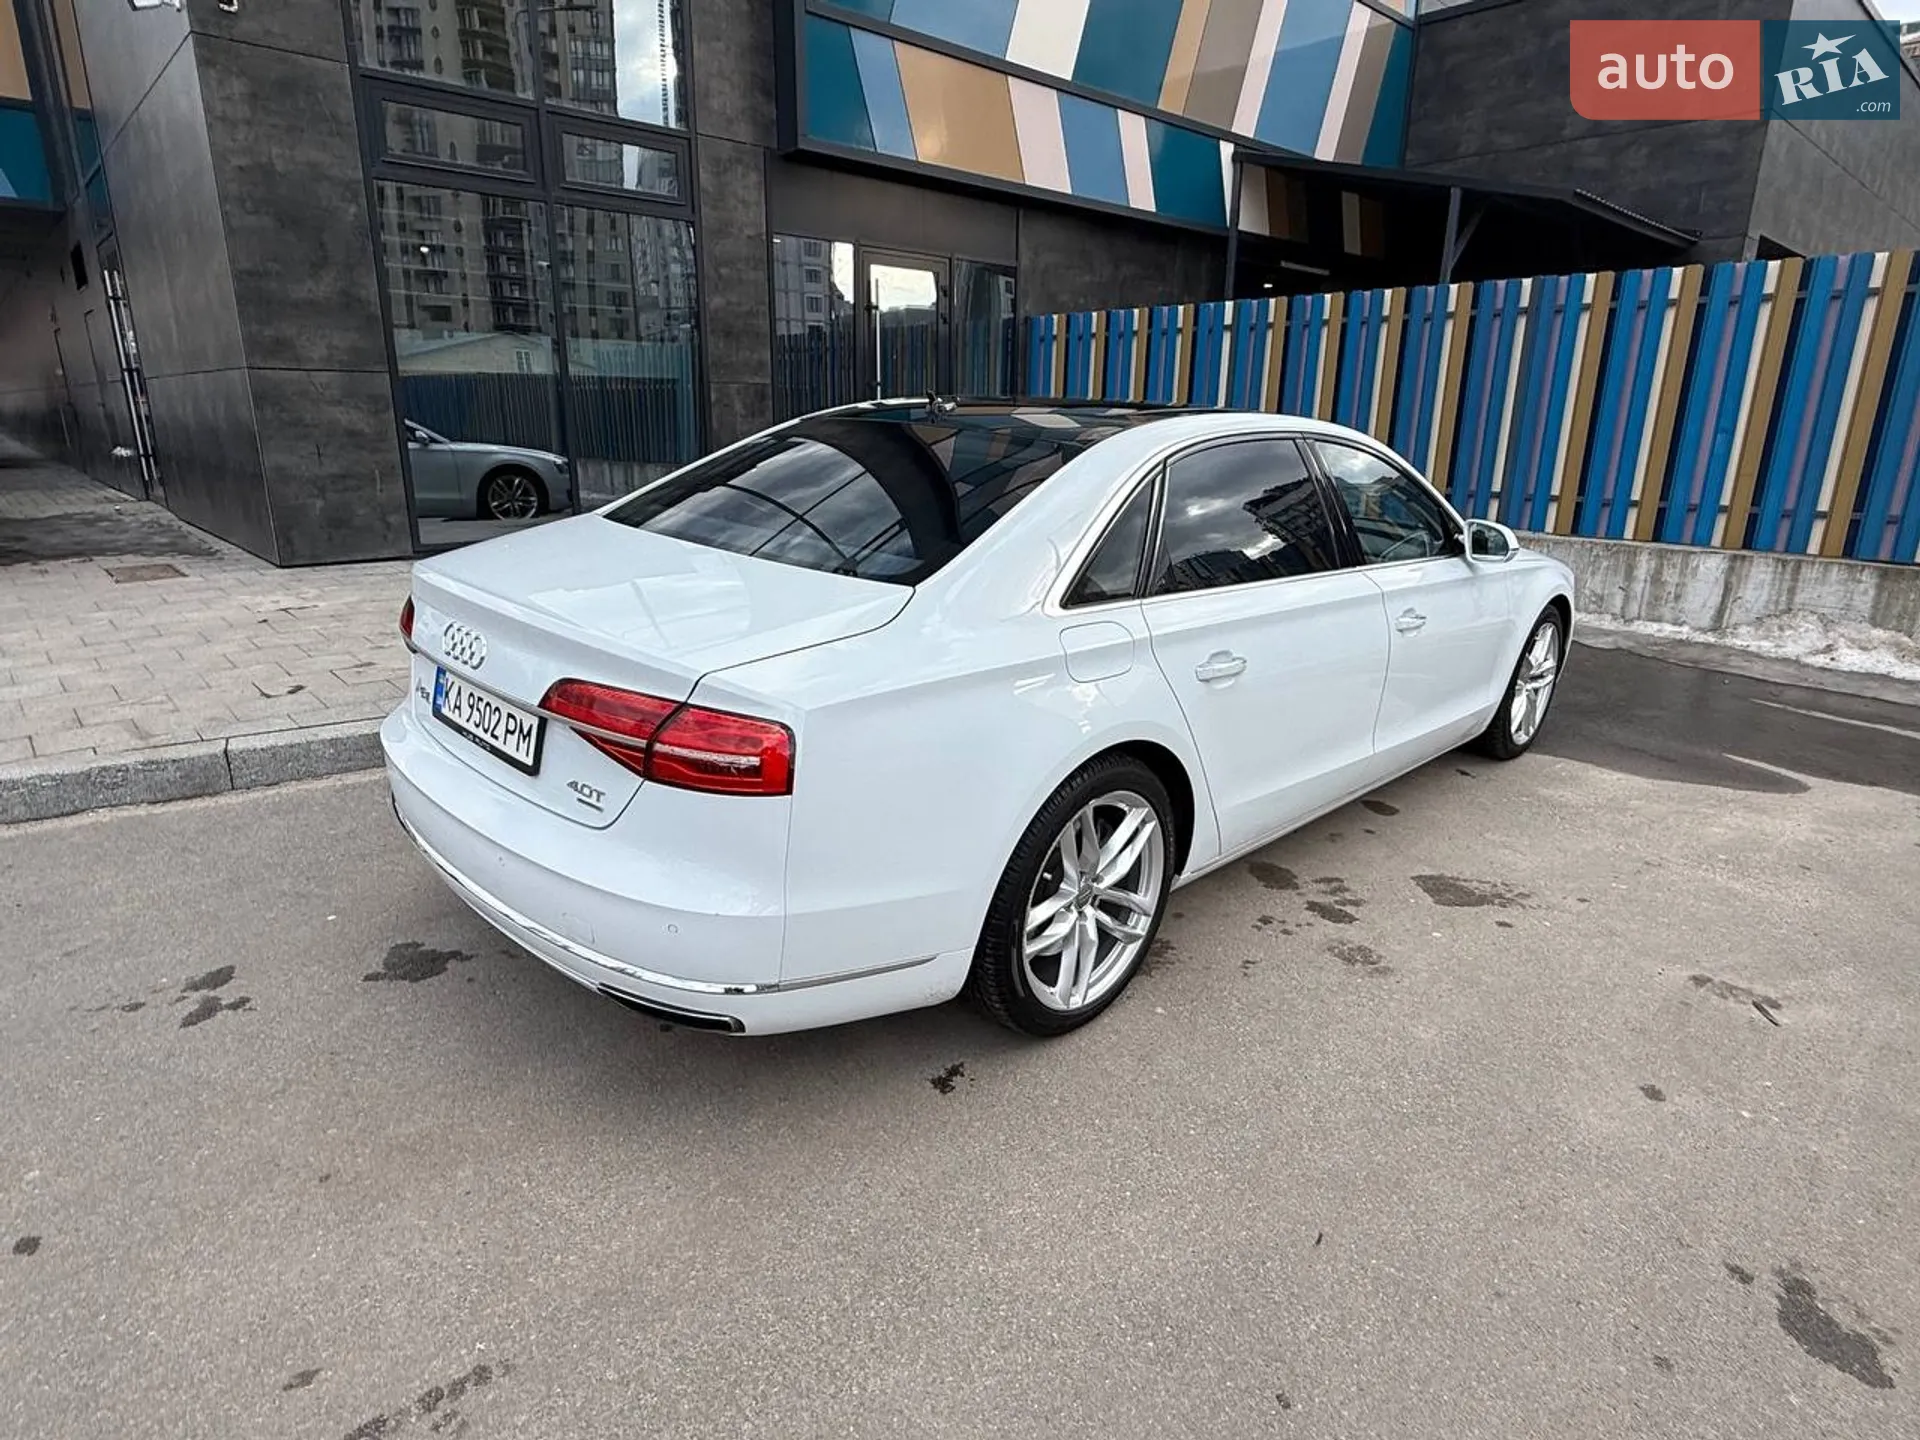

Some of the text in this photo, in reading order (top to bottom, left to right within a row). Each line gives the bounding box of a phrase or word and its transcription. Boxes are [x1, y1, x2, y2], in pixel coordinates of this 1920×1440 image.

[443, 678, 462, 718] KA
[466, 691, 502, 742] 9502
[503, 712, 534, 758] PM
